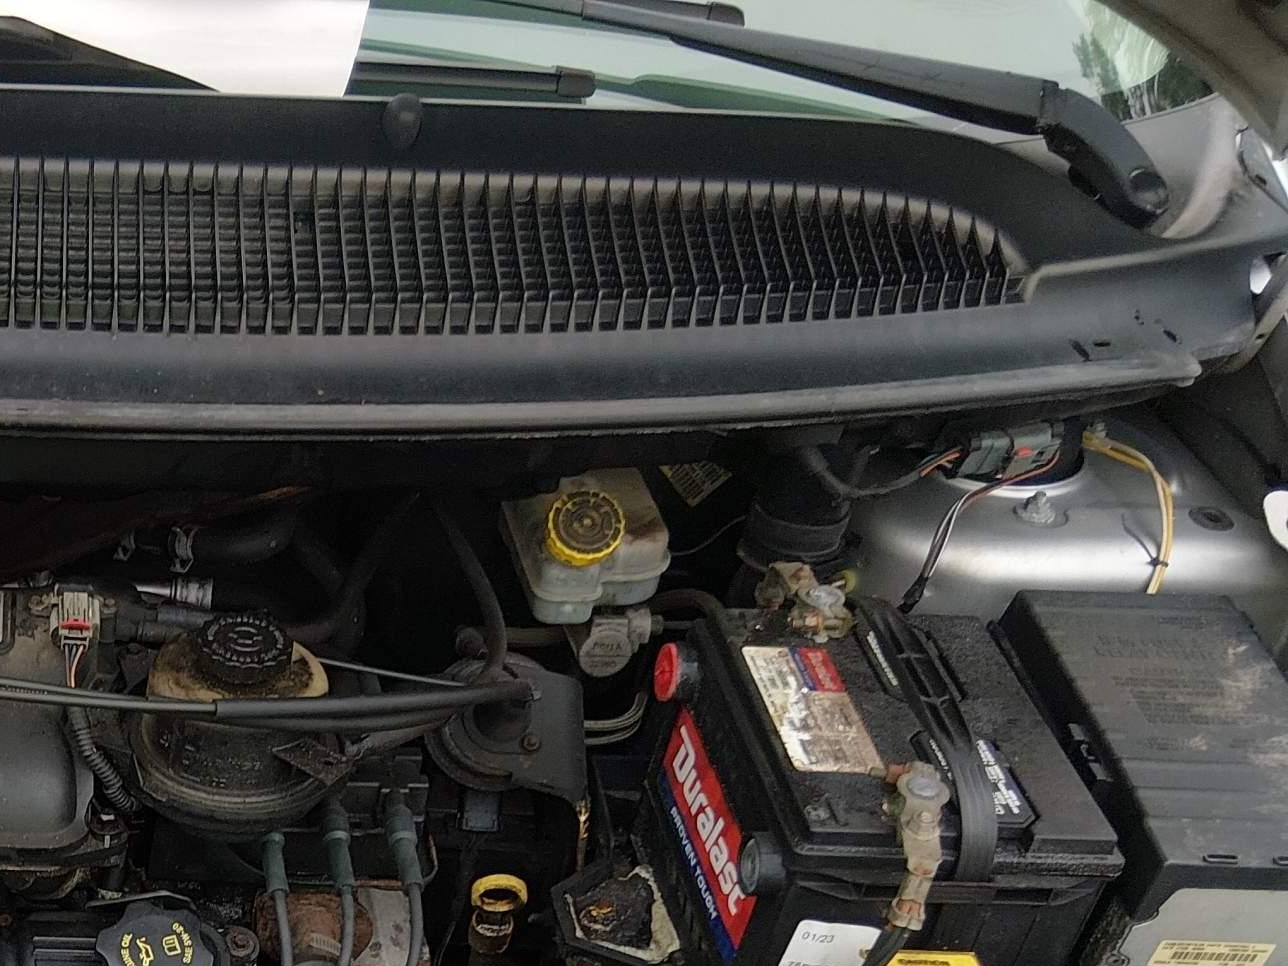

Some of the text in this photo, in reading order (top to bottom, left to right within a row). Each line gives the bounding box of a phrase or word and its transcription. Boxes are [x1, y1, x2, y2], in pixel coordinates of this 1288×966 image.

[672, 725, 746, 916] Duralast
[670, 806, 717, 920] PROVEN TOUGH
[121, 932, 133, 948] OIL
[172, 922, 194, 964] SAE 5W-20
[801, 931, 835, 944] 01/23
